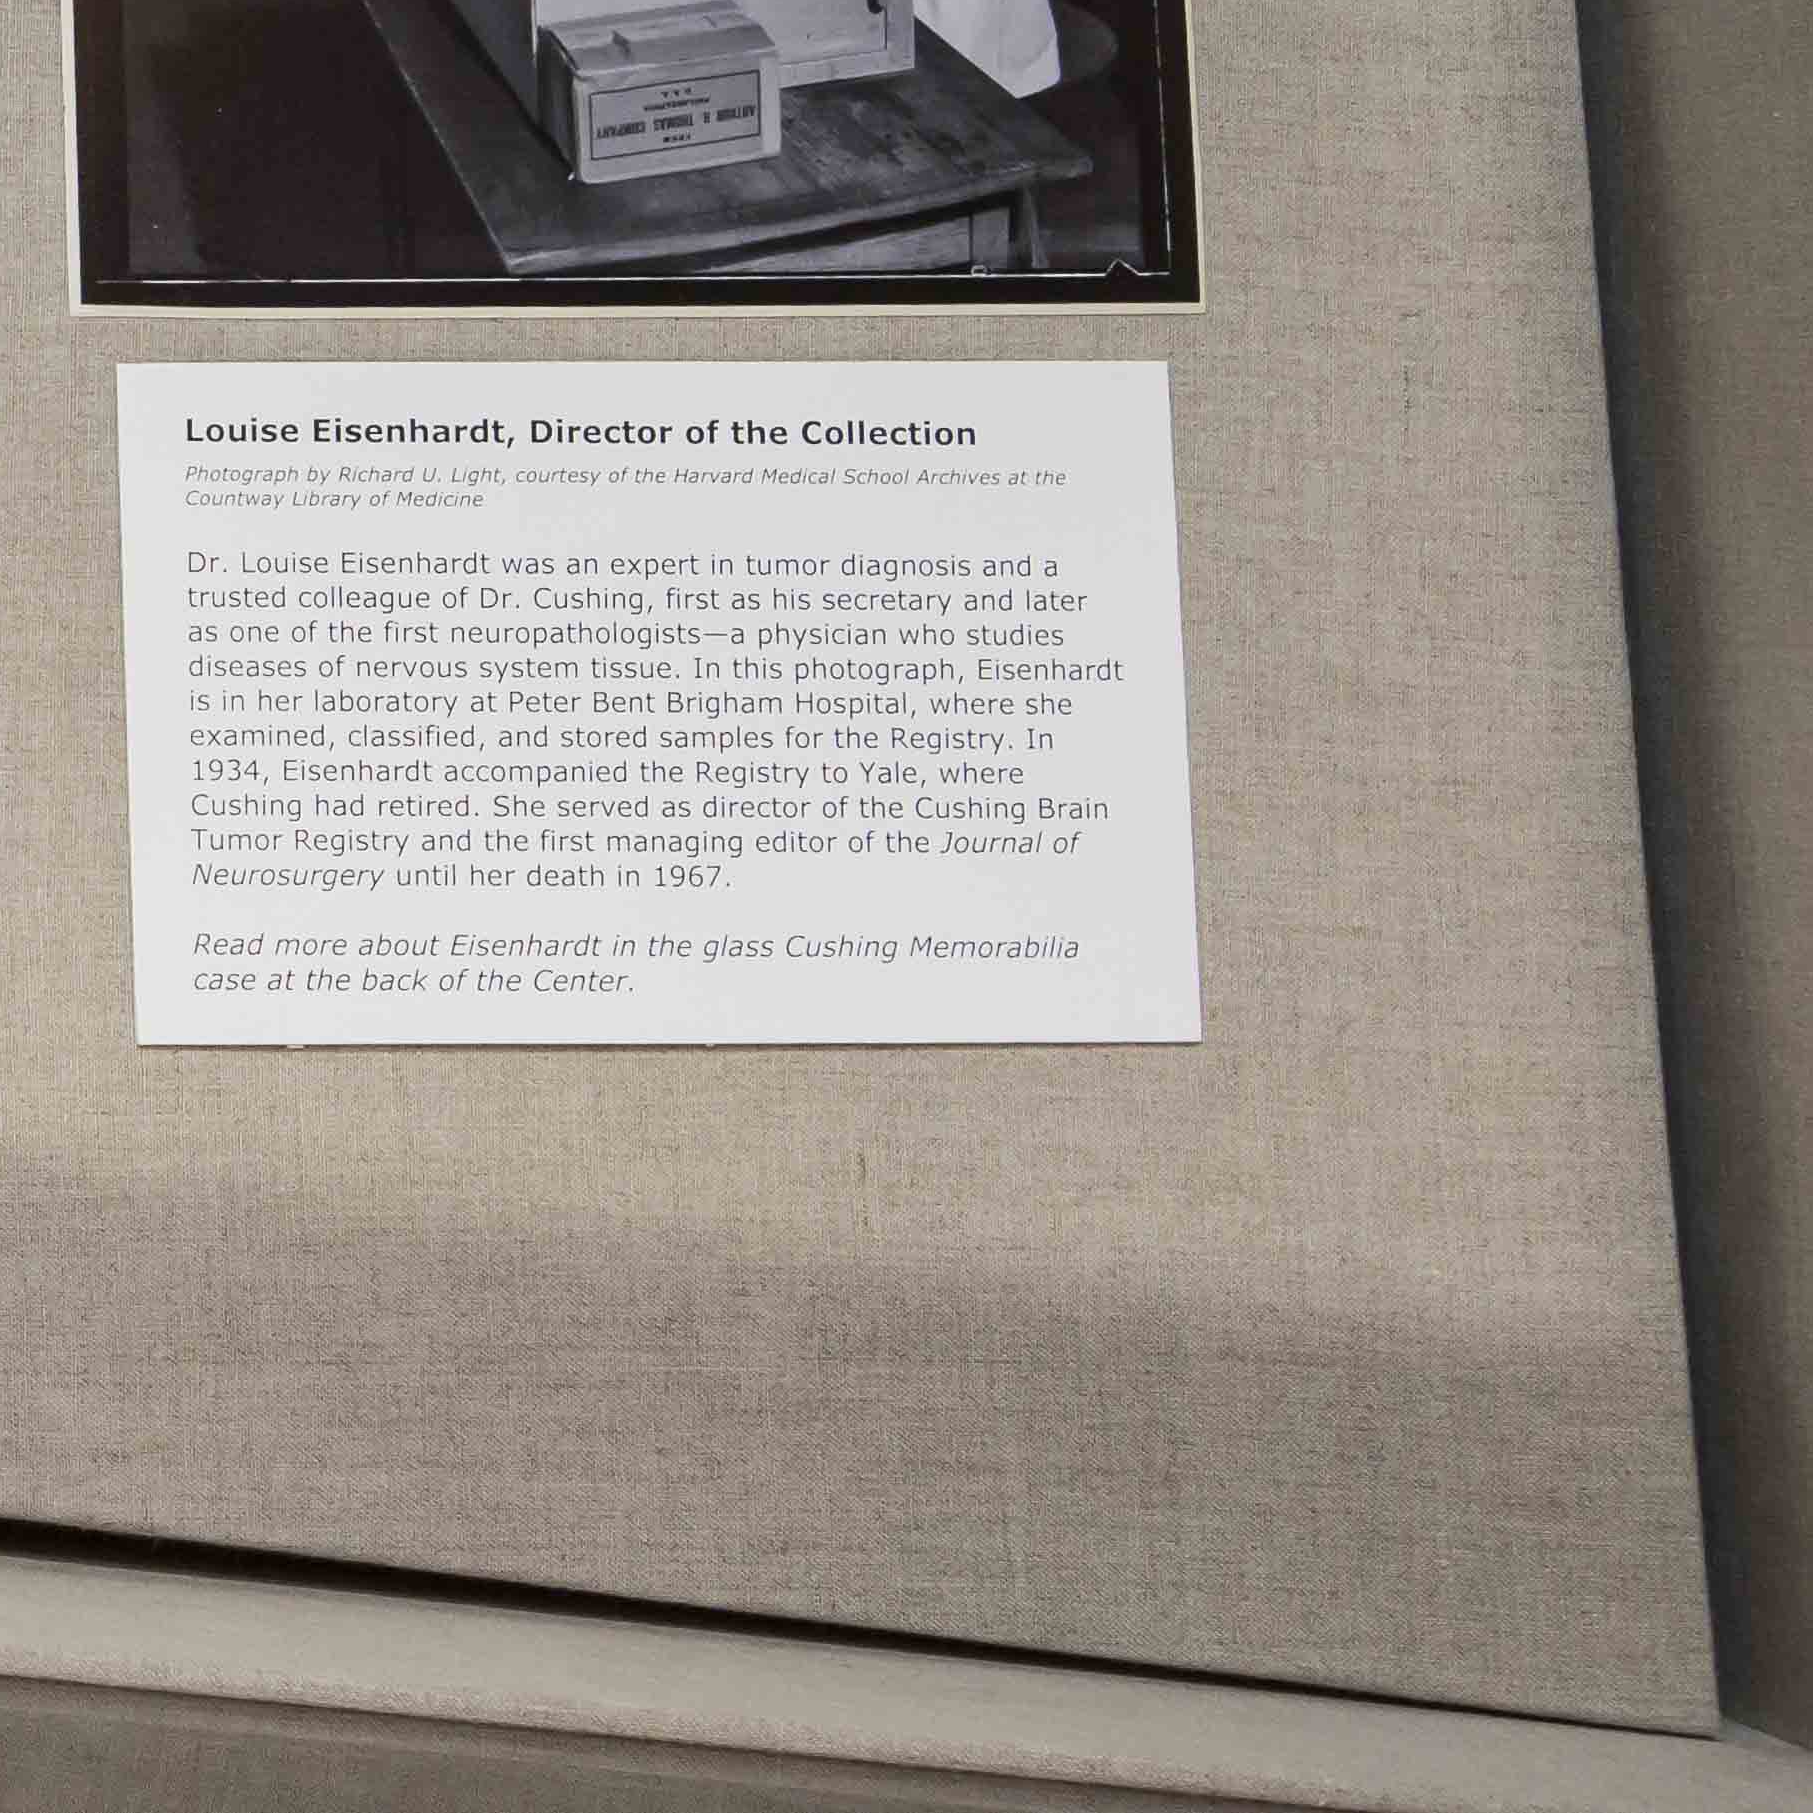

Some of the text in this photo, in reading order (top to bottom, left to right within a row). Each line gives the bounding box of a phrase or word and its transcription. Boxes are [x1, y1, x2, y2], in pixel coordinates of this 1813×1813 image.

[185, 416, 976, 450] Louise Eisenhardt, Director of the Collection
[185, 465, 1067, 487] Photograph by Richard U. Light, courtesy of the Harvard Medical School Archives at the
[184, 489, 484, 512] Countway Library of Medicine
[192, 862, 731, 892] Neurosurgery until her death in 1967.
[193, 931, 1080, 965] Read more about Eisenhardt in the glass Cushing Memorabilia
[193, 966, 634, 993] case at the back of the Center.
